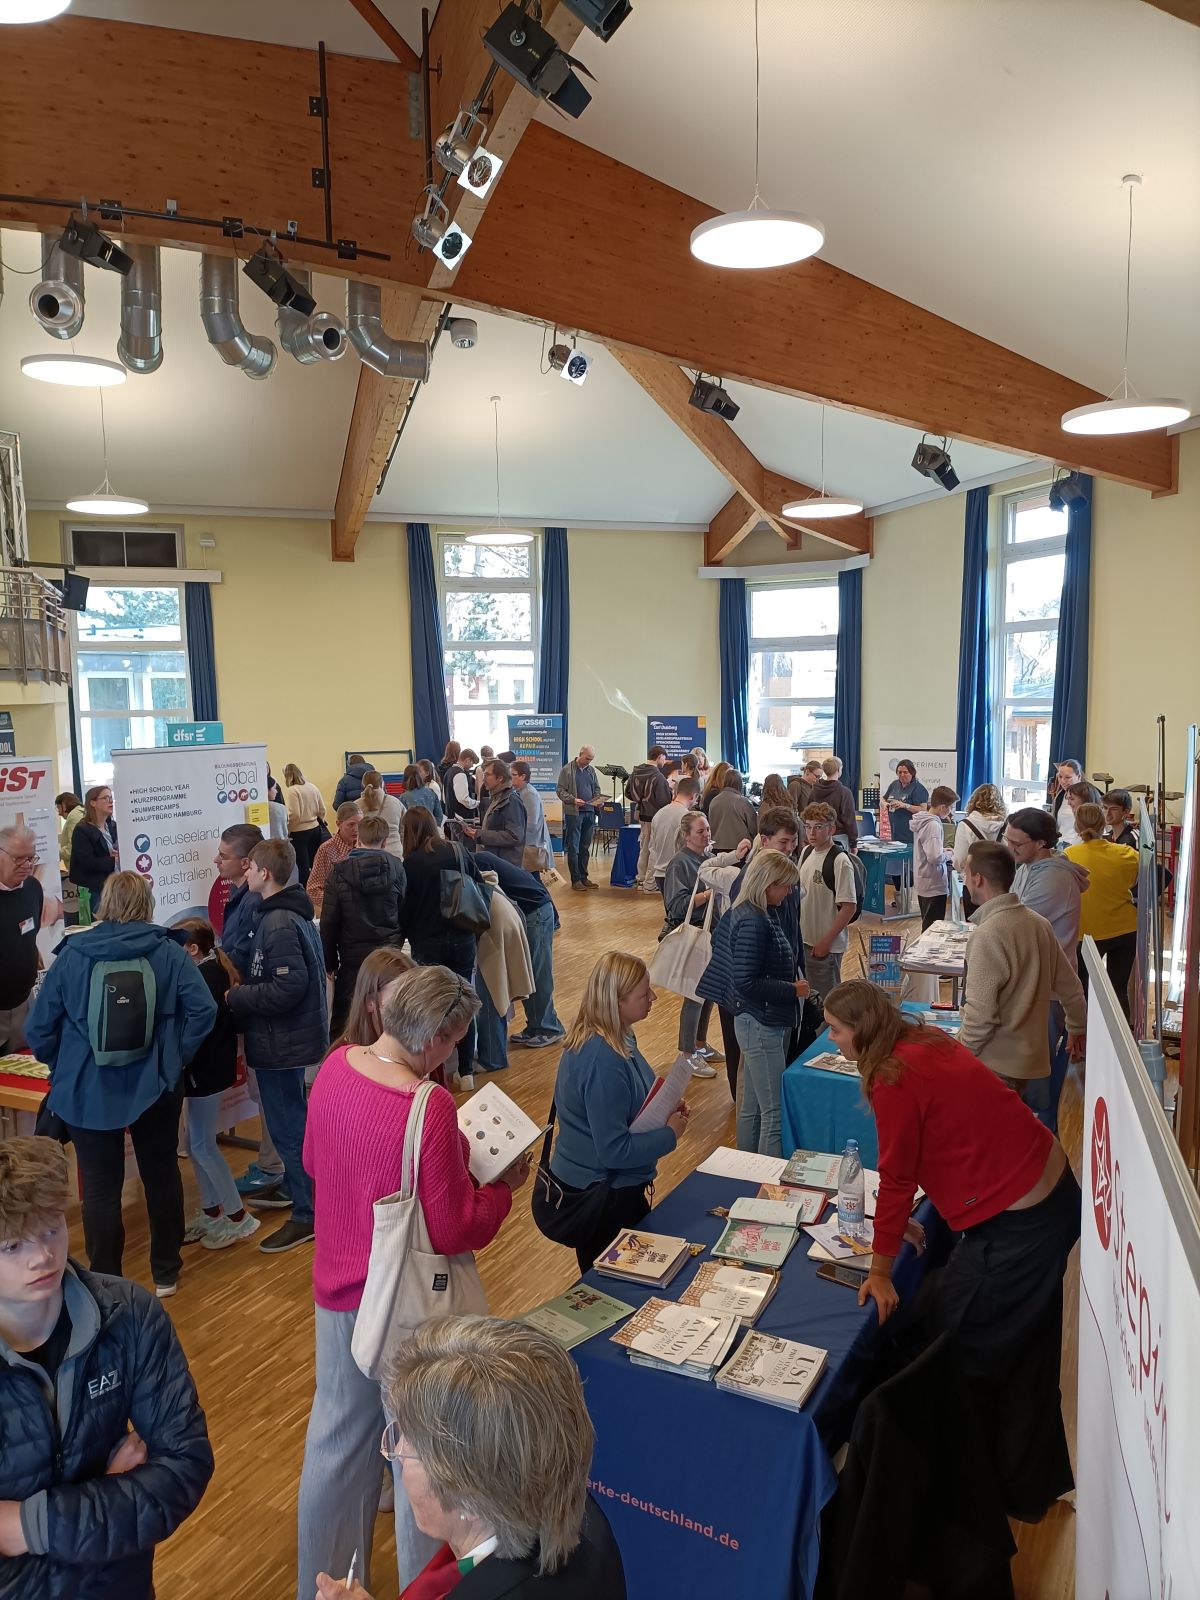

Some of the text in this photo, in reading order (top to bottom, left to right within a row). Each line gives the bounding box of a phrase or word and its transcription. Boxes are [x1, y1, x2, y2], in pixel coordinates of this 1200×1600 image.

[173, 729, 194, 742] dfsr
[216, 768, 258, 790] global
[133, 787, 148, 795] HIGH
[133, 793, 187, 804] KURZPROGRAMME
[135, 803, 180, 814] SUMMERCAMPS
[135, 810, 202, 822] HAUPTBÜRO HAMBURG
[156, 827, 220, 847] neuseeland
[157, 850, 199, 866] kanada
[158, 867, 212, 887] australien
[160, 890, 191, 906] irland
[663, 1318, 706, 1358] KANADA
[781, 1354, 816, 1389] USA
[88, 1369, 118, 1394] EA7
